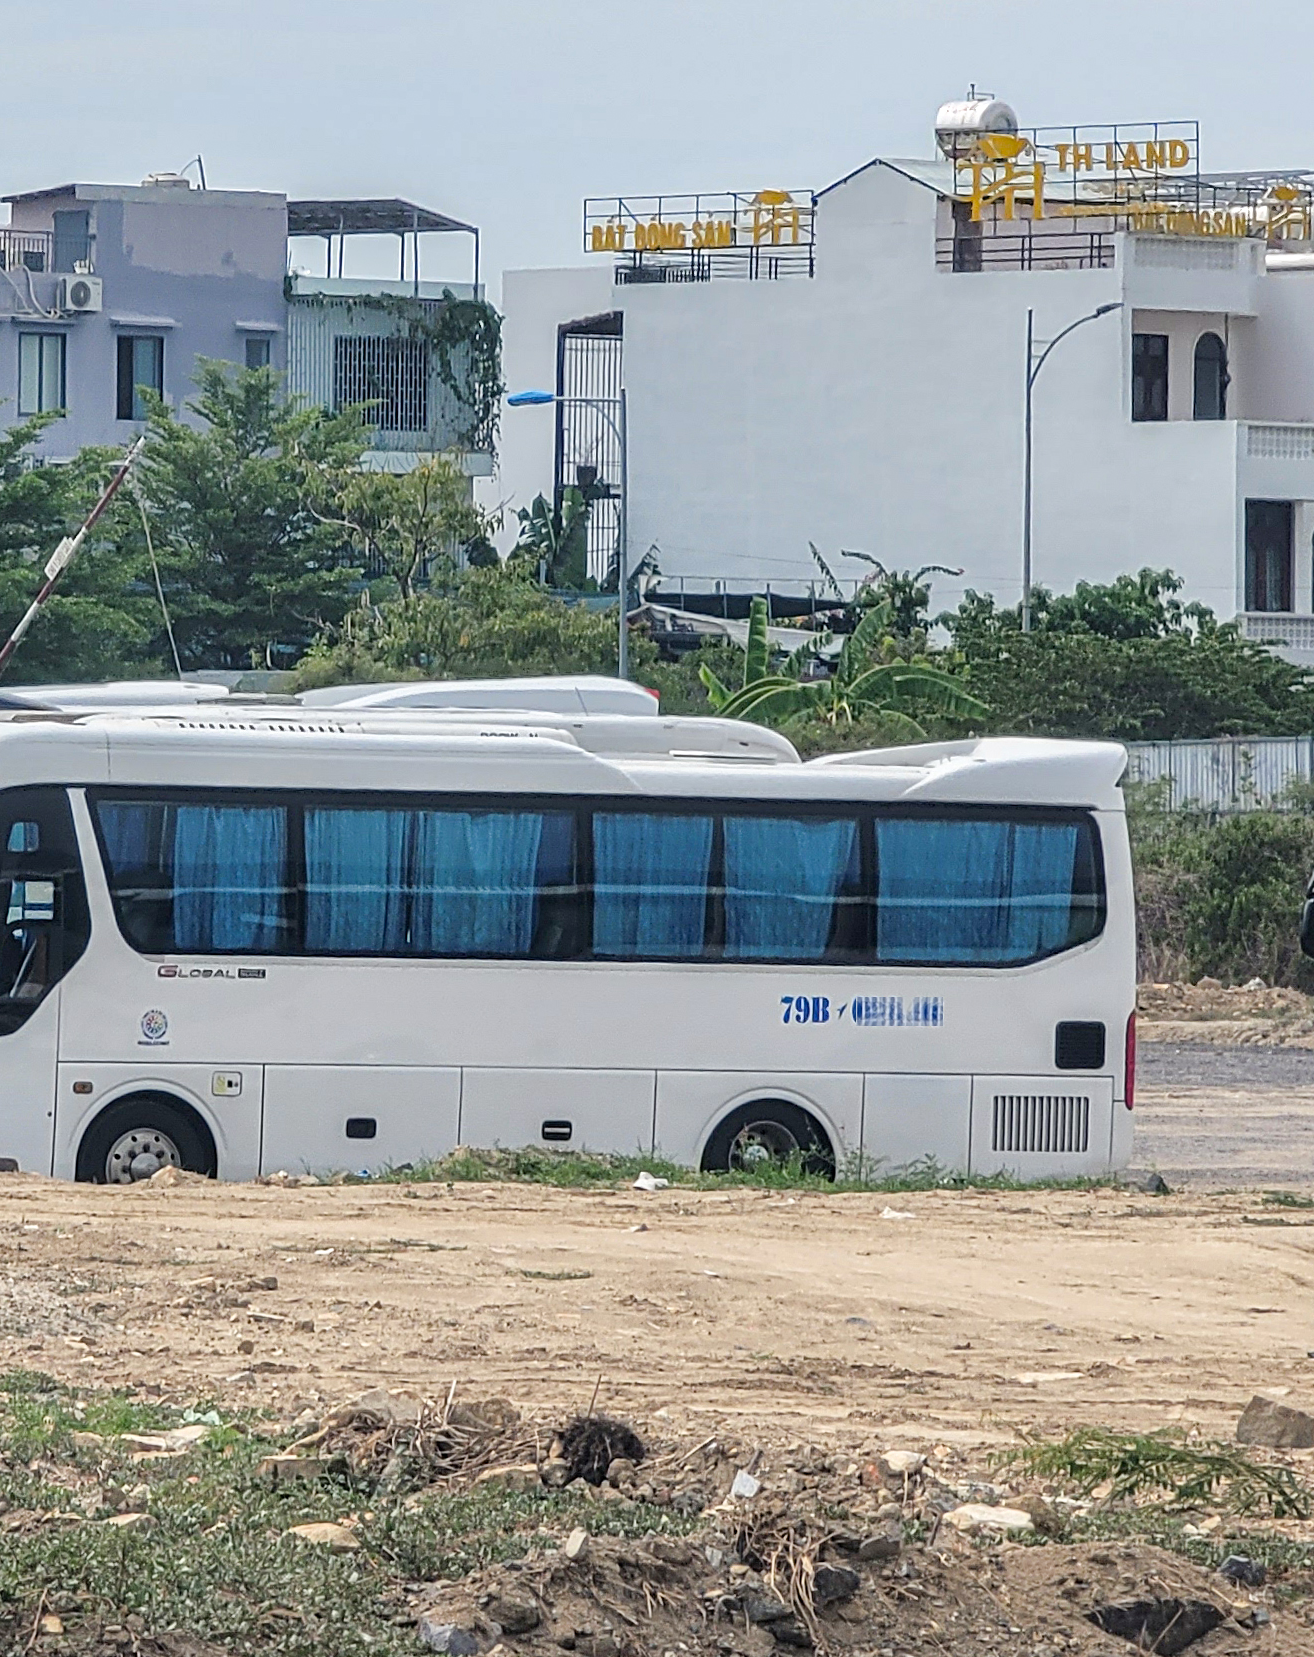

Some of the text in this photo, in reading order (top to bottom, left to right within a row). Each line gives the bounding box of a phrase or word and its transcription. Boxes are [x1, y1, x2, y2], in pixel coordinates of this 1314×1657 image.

[1055, 139, 1190, 172] TH LAND
[780, 996, 830, 1024] 79B
